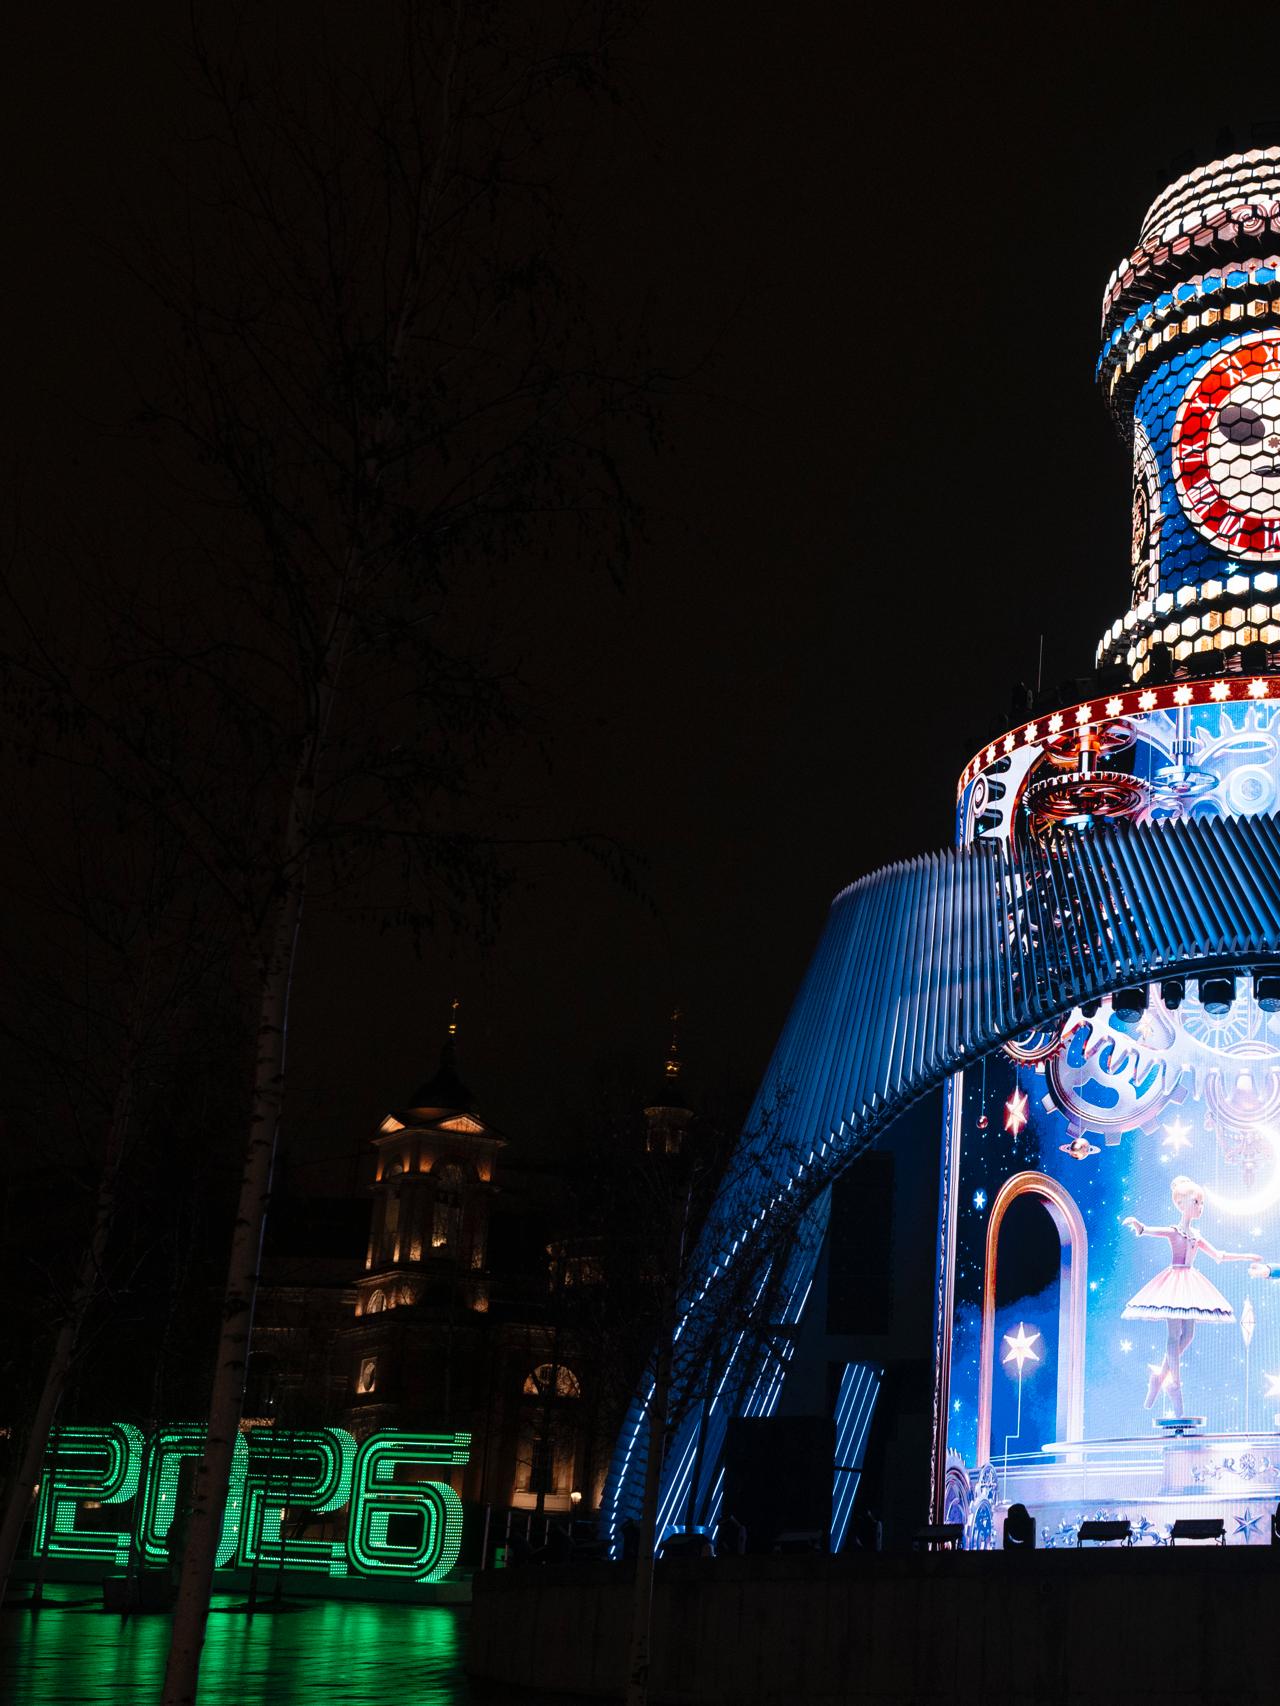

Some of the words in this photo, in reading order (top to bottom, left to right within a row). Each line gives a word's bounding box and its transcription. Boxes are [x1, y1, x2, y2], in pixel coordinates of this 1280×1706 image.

[1219, 355, 1247, 386] XI
[1190, 393, 1216, 419] X
[1181, 440, 1204, 463] IX
[32, 1421, 472, 1583] 2026
